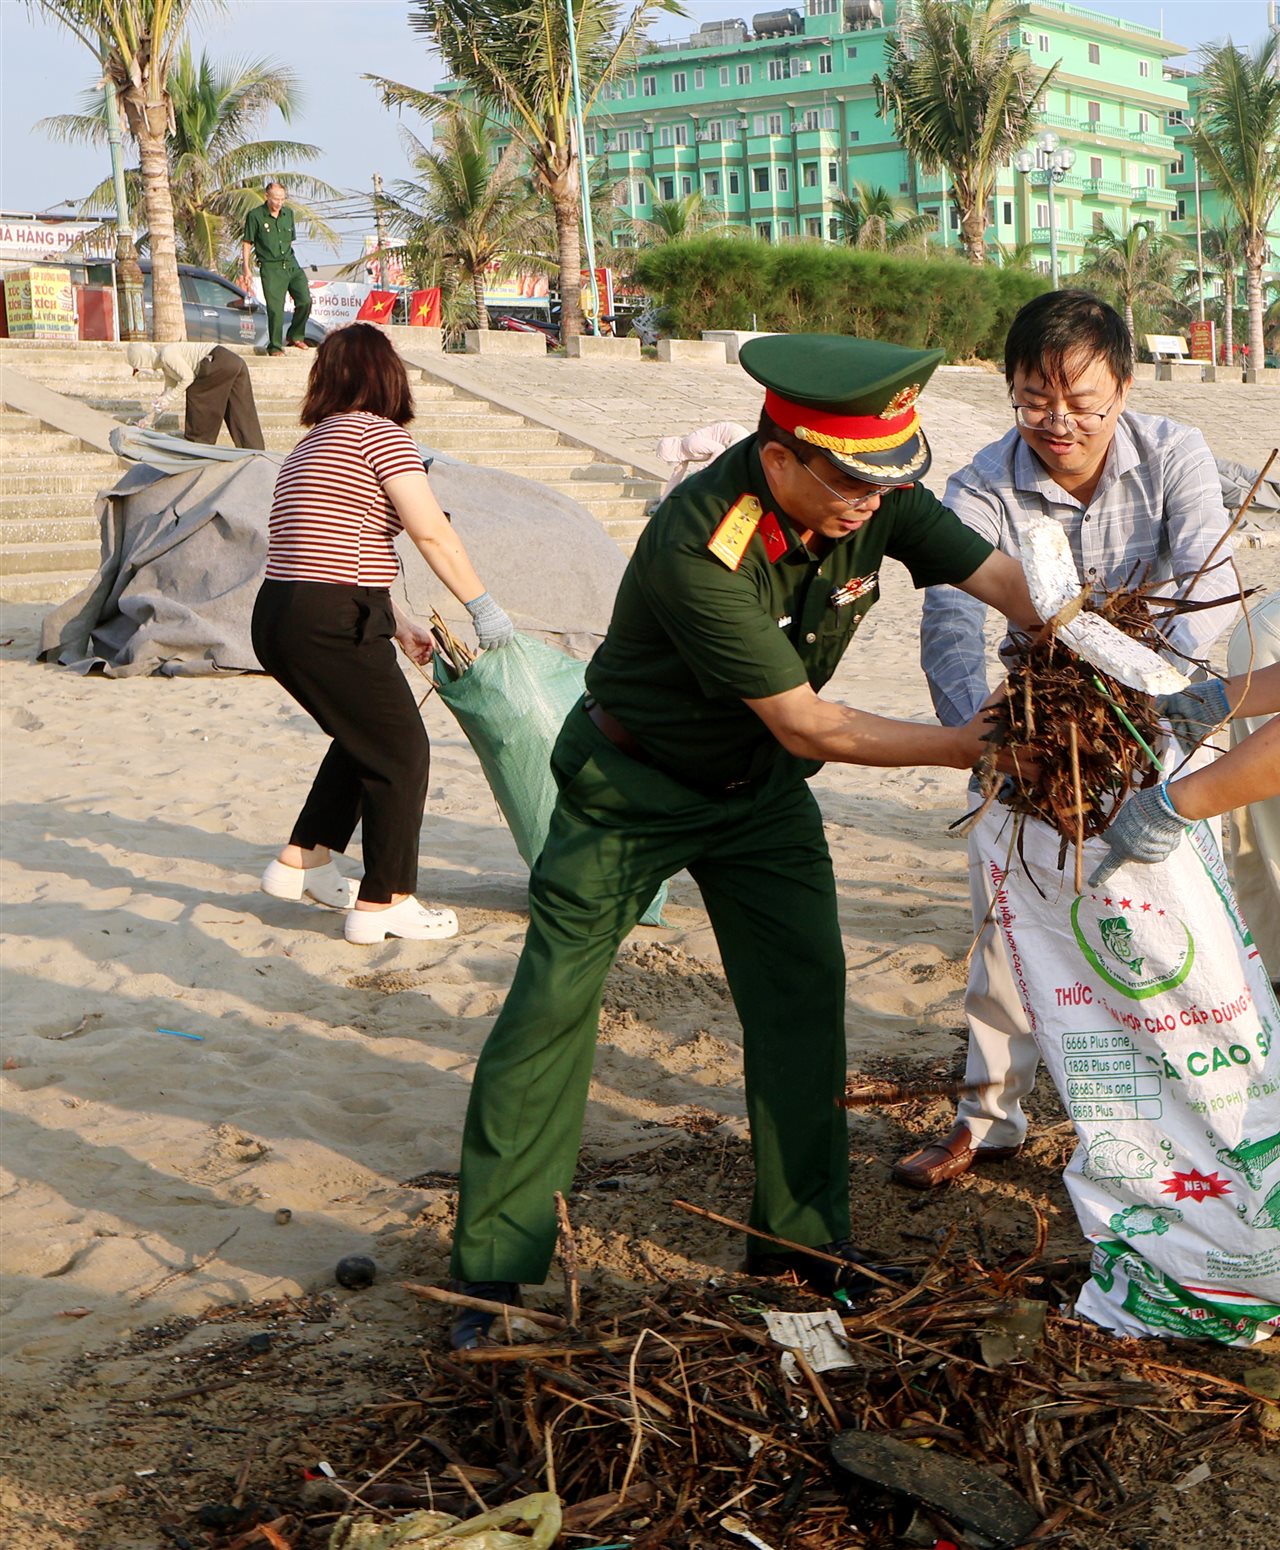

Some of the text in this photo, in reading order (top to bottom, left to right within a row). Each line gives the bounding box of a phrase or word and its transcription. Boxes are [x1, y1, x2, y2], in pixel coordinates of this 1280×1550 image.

[16, 226, 55, 245] HÀNG
[34, 284, 55, 295] XÚC
[34, 297, 57, 309] XÍCH
[1054, 982, 1093, 1007] THỨC
[1145, 1015, 1176, 1033] CAO
[1180, 1004, 1208, 1026] CẤP
[1212, 995, 1248, 1024] DÙNG
[1065, 1036, 1130, 1050] 6666 Plus one
[1069, 1059, 1131, 1073] 1828 Plus one
[1187, 1044, 1251, 1077] CAO
[1096, 1083, 1113, 1095] Plus
[1115, 1084, 1132, 1094] one
[1095, 1105, 1113, 1117] Plus
[1184, 1180, 1211, 1191] NEW
